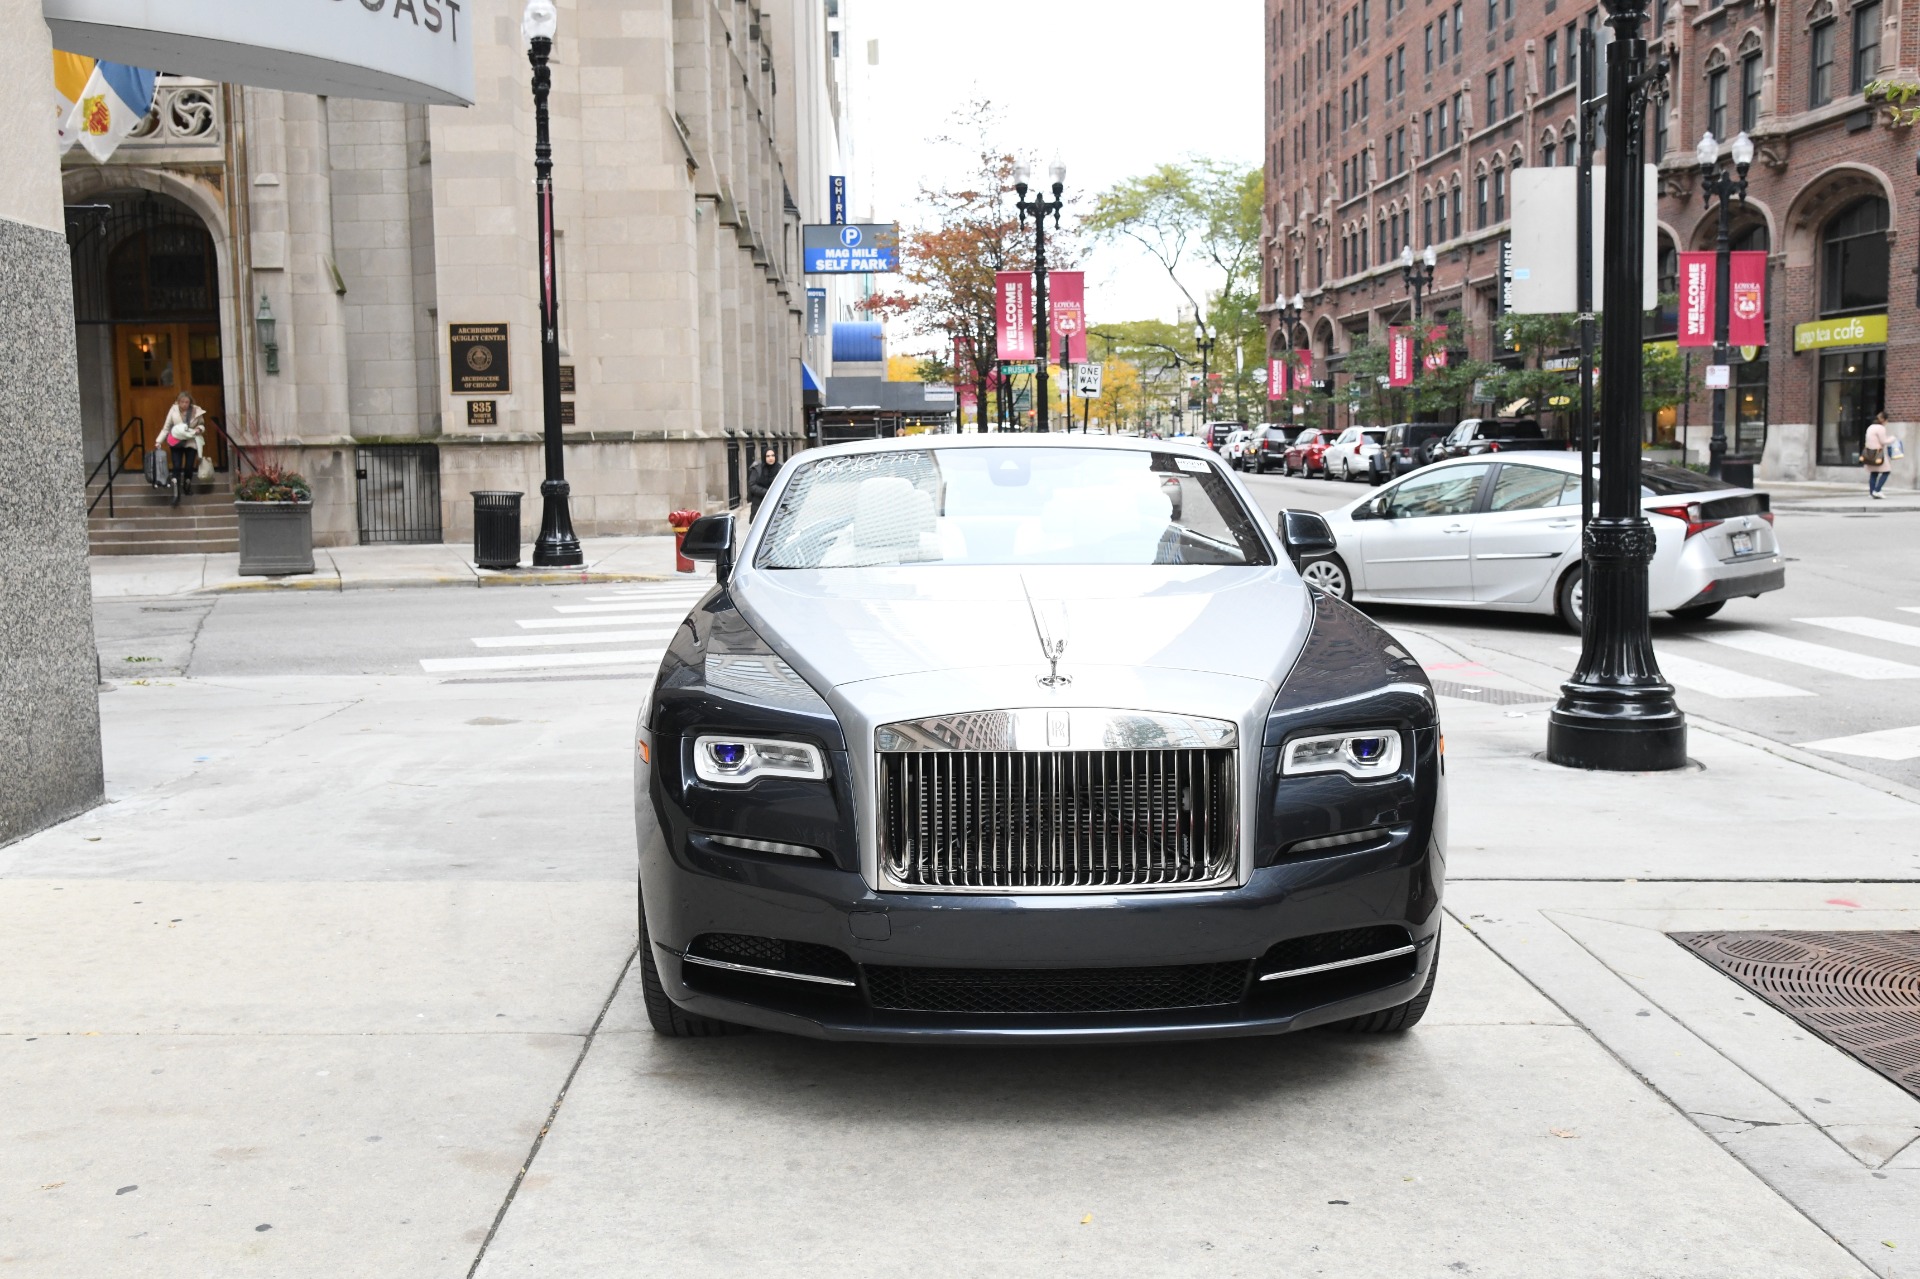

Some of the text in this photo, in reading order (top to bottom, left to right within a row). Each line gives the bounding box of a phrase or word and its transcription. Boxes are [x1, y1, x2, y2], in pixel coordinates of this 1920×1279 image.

[333, 0, 460, 42] AST
[845, 229, 858, 244] P
[825, 248, 878, 258] MAG MILE
[815, 258, 888, 271] SELF PARK
[1734, 282, 1760, 290] LOYOLA
[1687, 263, 1700, 335] WELCOME
[1005, 282, 1017, 352] WELCOME
[1816, 327, 1831, 342] tea
[1833, 318, 1865, 340] café
[1008, 366, 1027, 374] RUSH
[1080, 366, 1099, 376] ONE
[1080, 376, 1099, 385] WAY
[472, 402, 491, 413] 835
